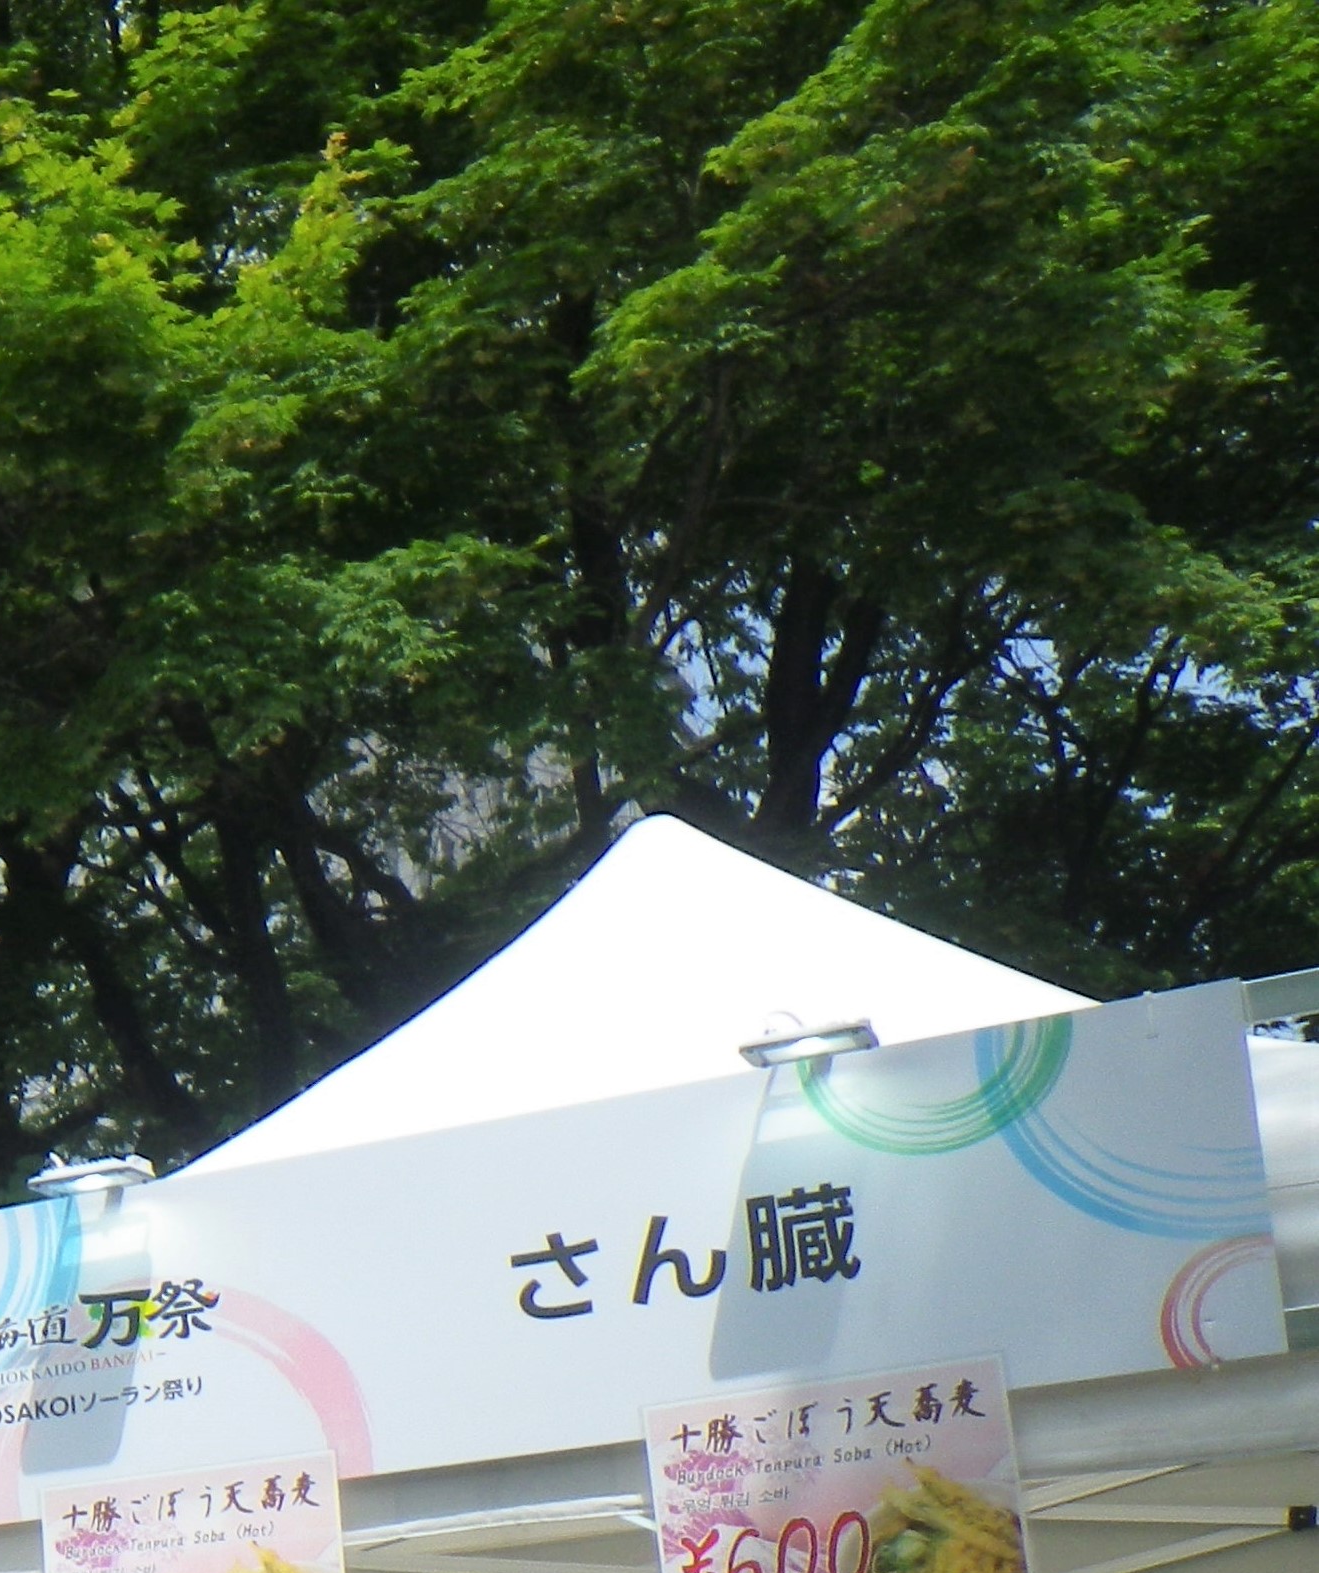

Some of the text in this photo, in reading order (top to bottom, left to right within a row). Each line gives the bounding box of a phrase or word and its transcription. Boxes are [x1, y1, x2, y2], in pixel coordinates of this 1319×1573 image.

[509, 1181, 863, 1321] さん臓
[671, 1378, 986, 1453] 十勝ごぼう天蕎麦
[677, 1465, 744, 1486] Burdock
[834, 1447, 872, 1463] Soba
[885, 1434, 932, 1456] (Hot)
[62, 1471, 320, 1533] 十勝ごぼう天蕎麦
[194, 1528, 225, 1544] Soba
[236, 1520, 275, 1538] (Hot)
